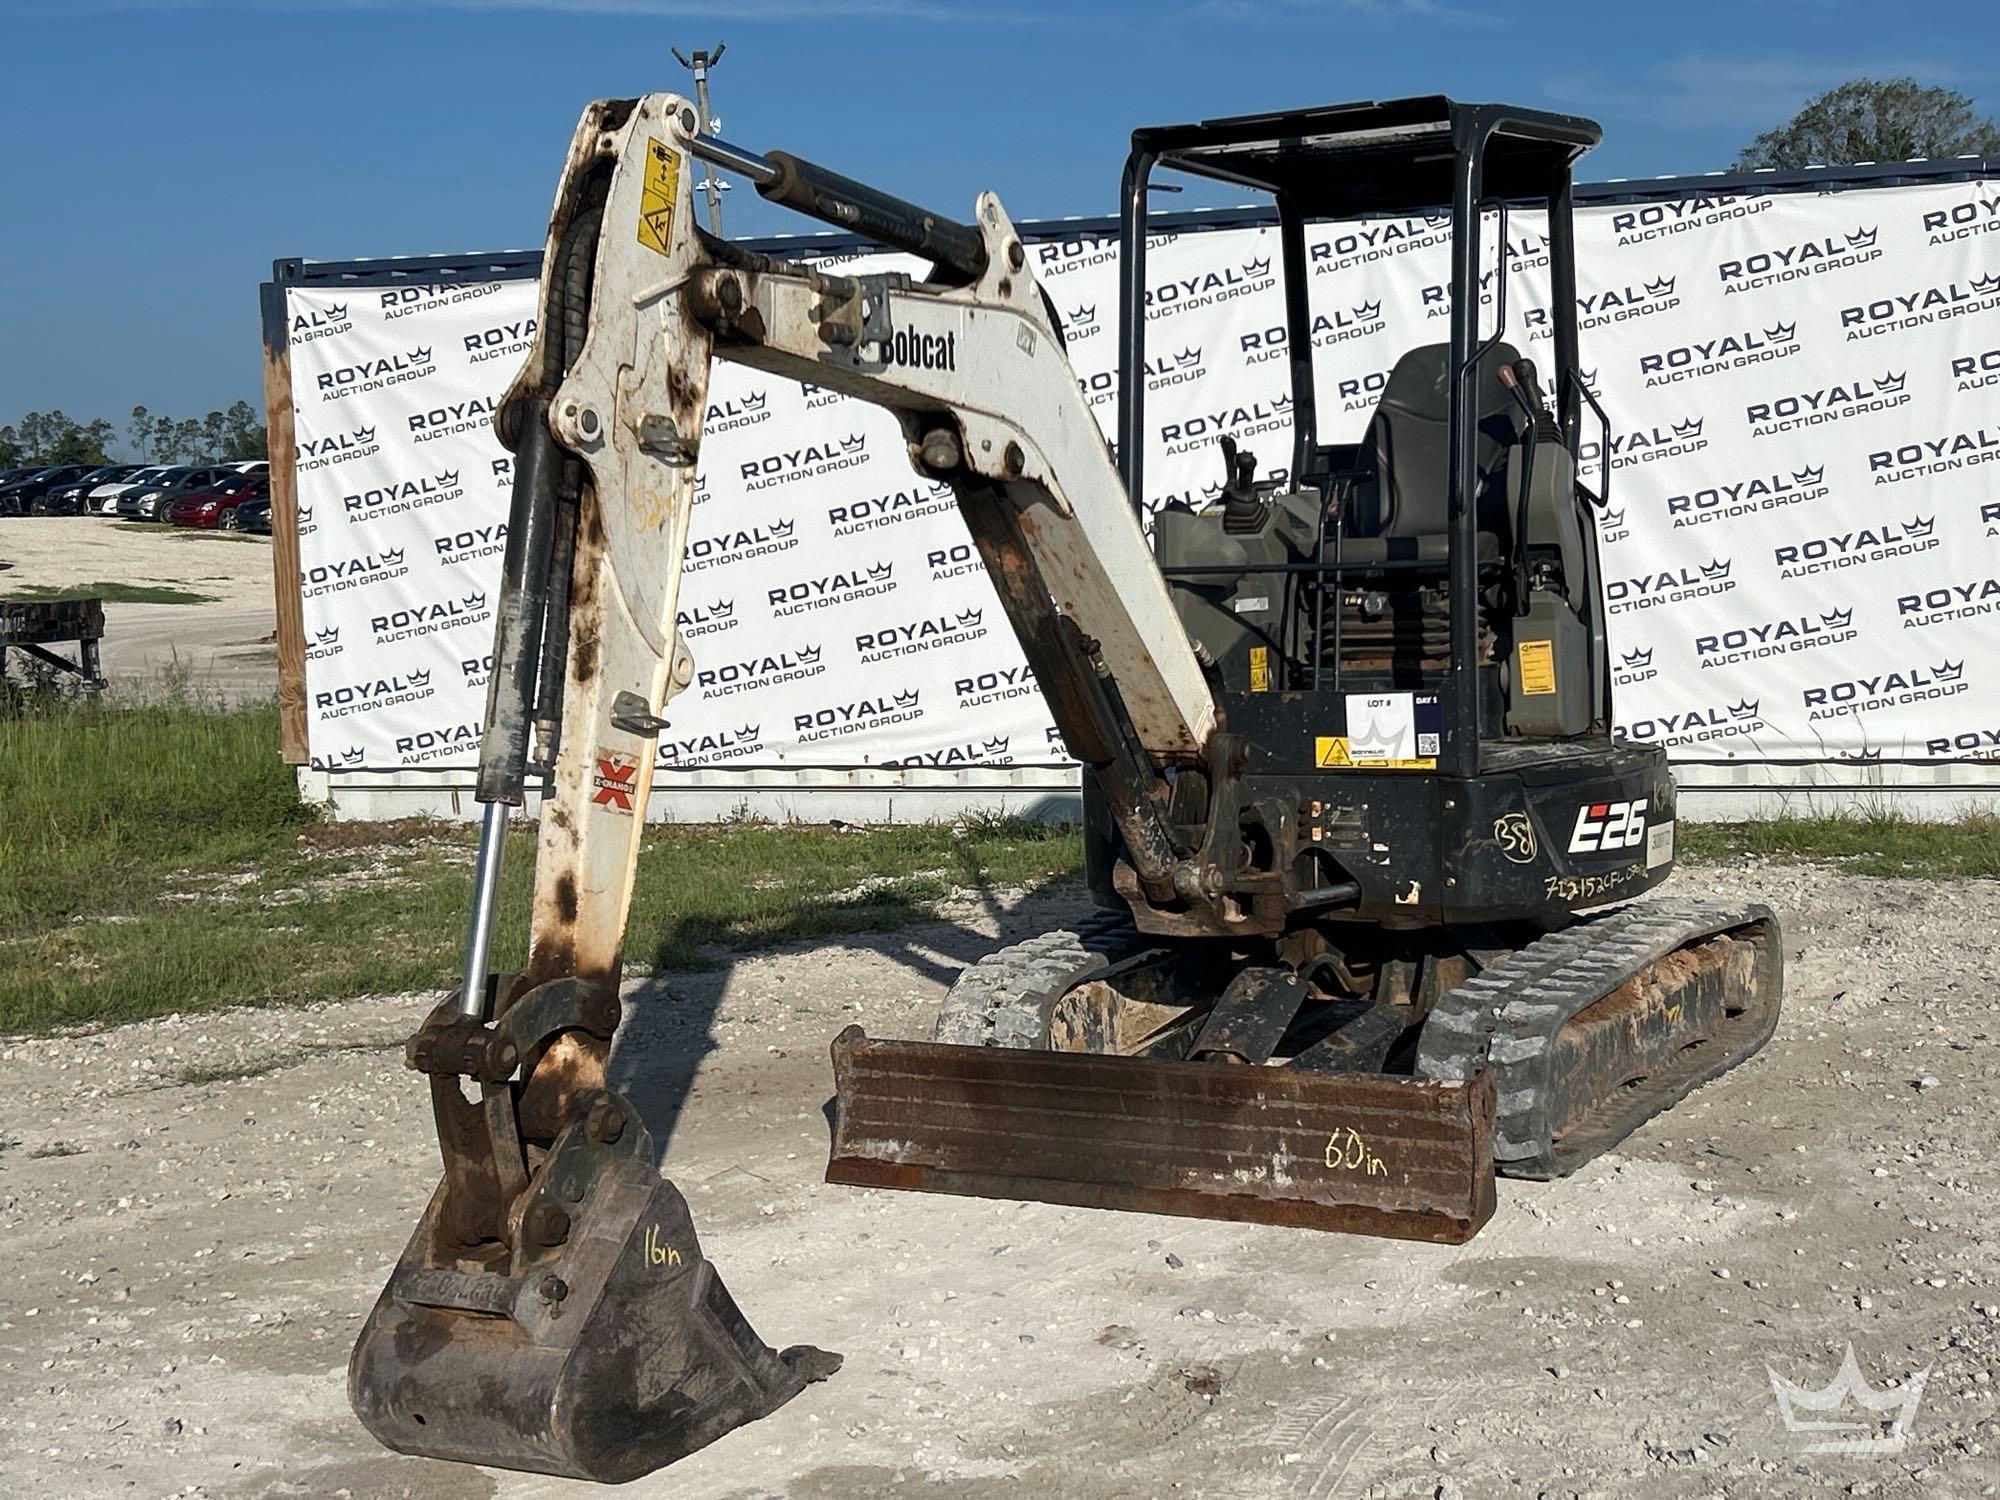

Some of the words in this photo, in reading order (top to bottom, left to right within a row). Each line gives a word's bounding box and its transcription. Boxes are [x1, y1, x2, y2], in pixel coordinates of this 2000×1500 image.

[1619, 218, 1701, 247] AUCTION
[1706, 200, 1772, 224] GROUP
[1923, 197, 2000, 231] ROY
[1310, 220, 1425, 262] ROYAL
[1929, 221, 2000, 246] AUCTIO
[1045, 251, 1116, 277] AUCTION
[1316, 247, 1392, 275] AUCTION
[1719, 238, 1845, 281] ROYAL
[1725, 267, 1810, 295] AUCTION
[1814, 249, 1882, 273] GROUP
[385, 298, 449, 320] AUCTION
[452, 284, 501, 303] GROUP
[1216, 279, 1275, 301] GROUP
[1841, 284, 1970, 327] ROYAL
[1615, 298, 1680, 321] GROUP
[305, 323, 352, 341] GROUP
[464, 320, 536, 351] ROYA
[1067, 325, 1100, 341] OUP
[1326, 322, 1385, 344] GROUP
[1847, 313, 1933, 341] AUCTION
[881, 323, 955, 371] Bobcat
[1640, 333, 1764, 374] ROYAL
[317, 356, 408, 390] ROYAL
[1148, 368, 1206, 390] GROUP
[1646, 361, 1729, 388] AUCTION
[1734, 344, 1800, 367] GROUP
[323, 380, 383, 401] AUCTION
[387, 366, 436, 385] GROUP
[1747, 382, 1874, 424] ROYAL
[1753, 411, 1838, 438] AUCTION
[1843, 395, 1911, 417] GROUP
[414, 421, 476, 443] AUCTION
[718, 412, 771, 431] GROUP
[1161, 404, 1271, 443] ROYAL
[1245, 417, 1292, 438] GROU
[295, 434, 354, 461] YAL
[297, 458, 330, 472] TION
[333, 445, 379, 463] GROUP
[741, 443, 840, 479] ROYAL
[1642, 440, 1707, 462] GROUP
[1869, 430, 1999, 471] ROYAL
[746, 468, 813, 492] AUCTION
[816, 454, 869, 474] GROUP
[1875, 458, 1962, 485] AUCTION
[344, 479, 436, 512] ROYAL
[350, 502, 410, 523] AUCTION
[413, 489, 463, 508] GROUP
[829, 489, 929, 525] ROYAL
[1668, 475, 1792, 515] ROYAL
[1674, 503, 1757, 529] AUCTION
[1762, 488, 1829, 509] GROUP
[435, 524, 508, 554] ROYA
[834, 513, 901, 537] AUCTION
[442, 544, 503, 566] AUCTION
[746, 539, 798, 558] GROUP
[1775, 526, 1902, 565] ROYAL
[1781, 554, 1866, 579] AUCTION
[1871, 539, 1939, 560] GROUP
[303, 579, 357, 598] UCTION
[360, 567, 408, 585] GROUP
[932, 562, 983, 581] AUCTI
[1607, 568, 1700, 600] OYAL
[768, 571, 867, 606] ROYAL
[774, 596, 840, 618] AUCTION
[844, 582, 896, 601] GROUP
[1609, 595, 1665, 614] CTION
[1670, 581, 1735, 602] GROUP
[1898, 579, 2000, 615] ROYA
[371, 601, 463, 633] ROYAL
[377, 624, 437, 644] AUCTION
[441, 612, 490, 629] GROUP
[686, 619, 738, 638] GROUP
[1904, 604, 1991, 629] AUCTION
[856, 617, 957, 652] ROYAL
[861, 642, 928, 664] AUCTION
[932, 629, 987, 648] GROUP
[1696, 618, 1821, 655] ROYAL
[1701, 644, 1786, 669] AUCTION
[1790, 630, 1857, 651] GROUP
[305, 646, 343, 660] ROUP
[698, 654, 796, 687] ROYAL
[703, 678, 769, 699] AUCTION
[773, 665, 825, 684] GROUP
[955, 666, 1036, 696] ROYA
[316, 677, 407, 708] ROYAL
[321, 700, 382, 720] AUCTION
[385, 689, 434, 705] GROUP
[960, 686, 1030, 709] AUCTION
[1367, 700, 1385, 708] LOT
[1803, 670, 1931, 707] ROYAL
[1809, 697, 1895, 721] AUCTION
[1899, 683, 1968, 704] GROUP
[794, 698, 894, 731] ROYAL
[798, 722, 865, 743] AUCTION
[870, 710, 923, 728] GROUP
[659, 733, 734, 759] OYAL
[1697, 722, 1763, 741] GROUP
[402, 744, 464, 764] AUCTION
[712, 744, 763, 761] GROUP
[1568, 799, 1648, 853] E26
